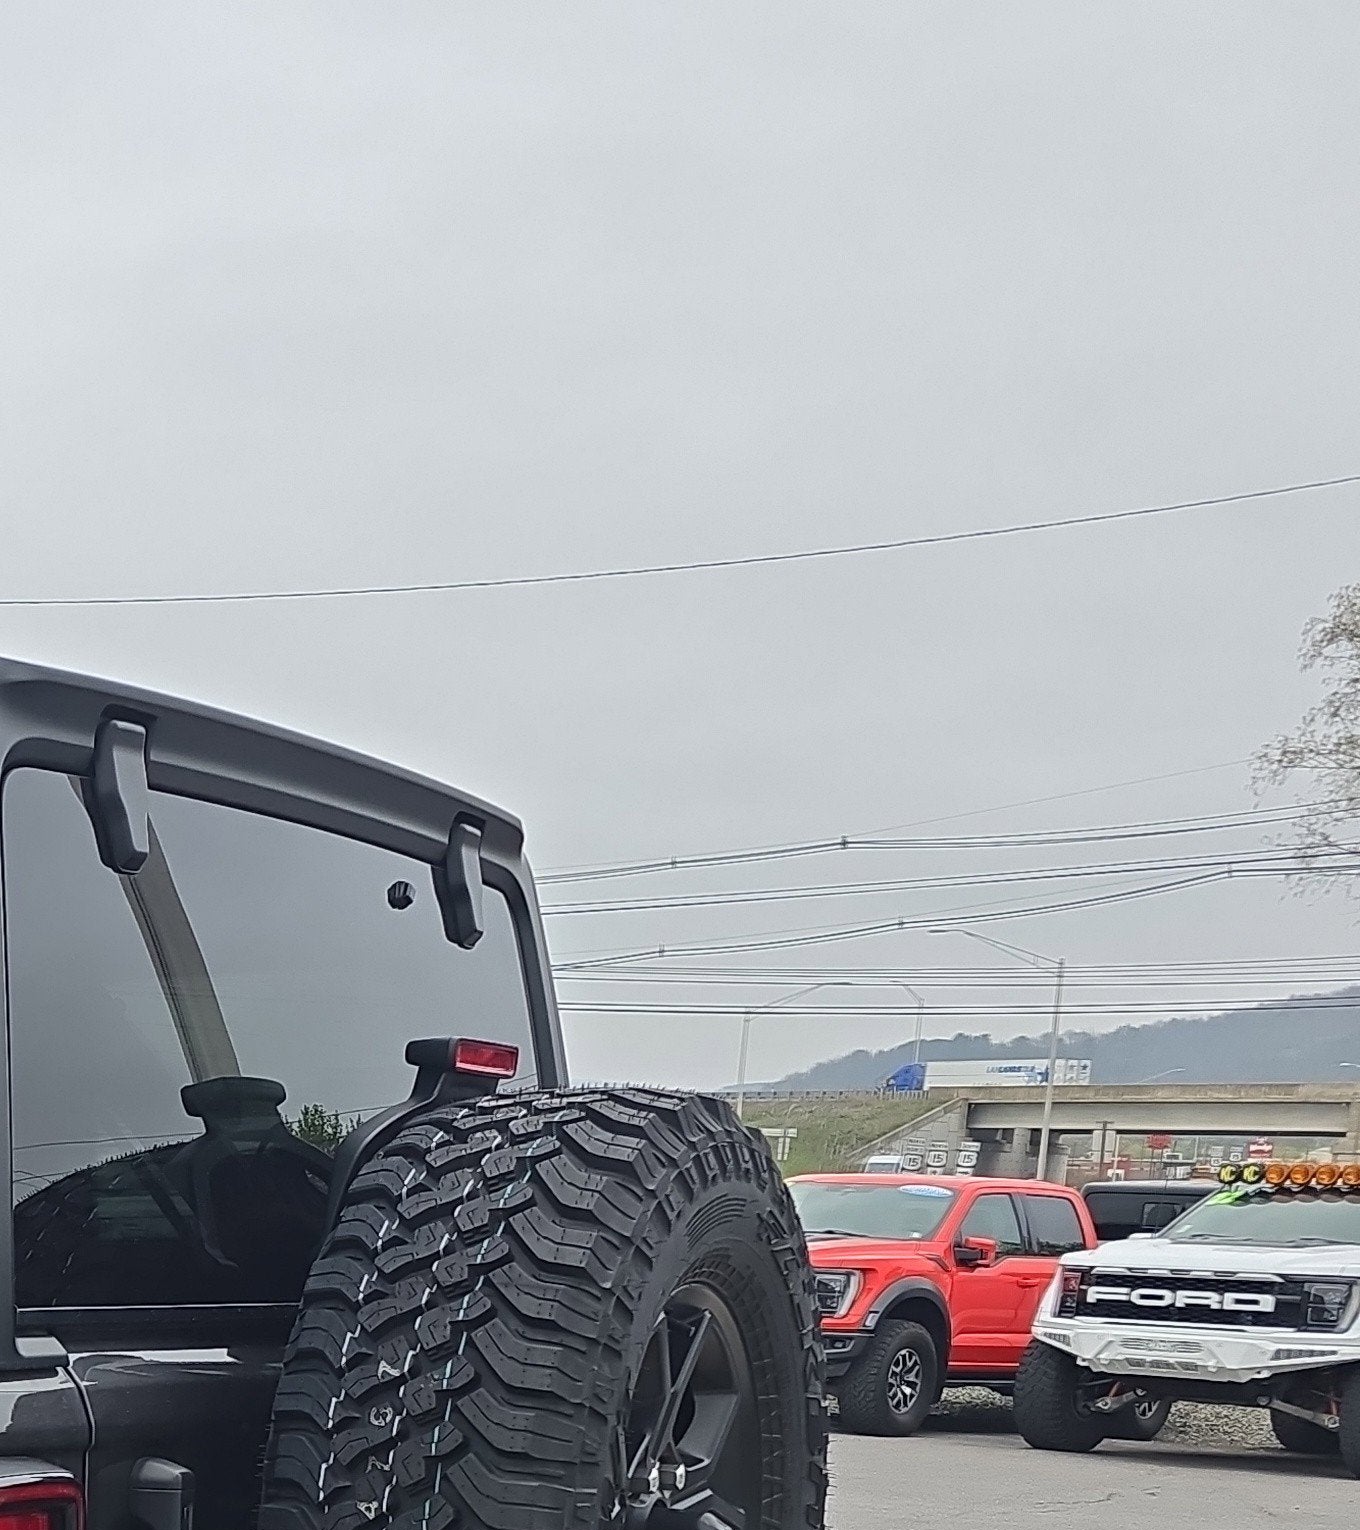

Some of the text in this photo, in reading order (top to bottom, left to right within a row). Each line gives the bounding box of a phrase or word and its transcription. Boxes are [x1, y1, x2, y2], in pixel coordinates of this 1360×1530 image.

[908, 1157, 919, 1167] 15
[932, 1153, 943, 1163] 15
[962, 1153, 973, 1164] 15
[1220, 1164, 1237, 1182] KC
[1243, 1164, 1260, 1183] KC
[1086, 1285, 1276, 1313] FORD
